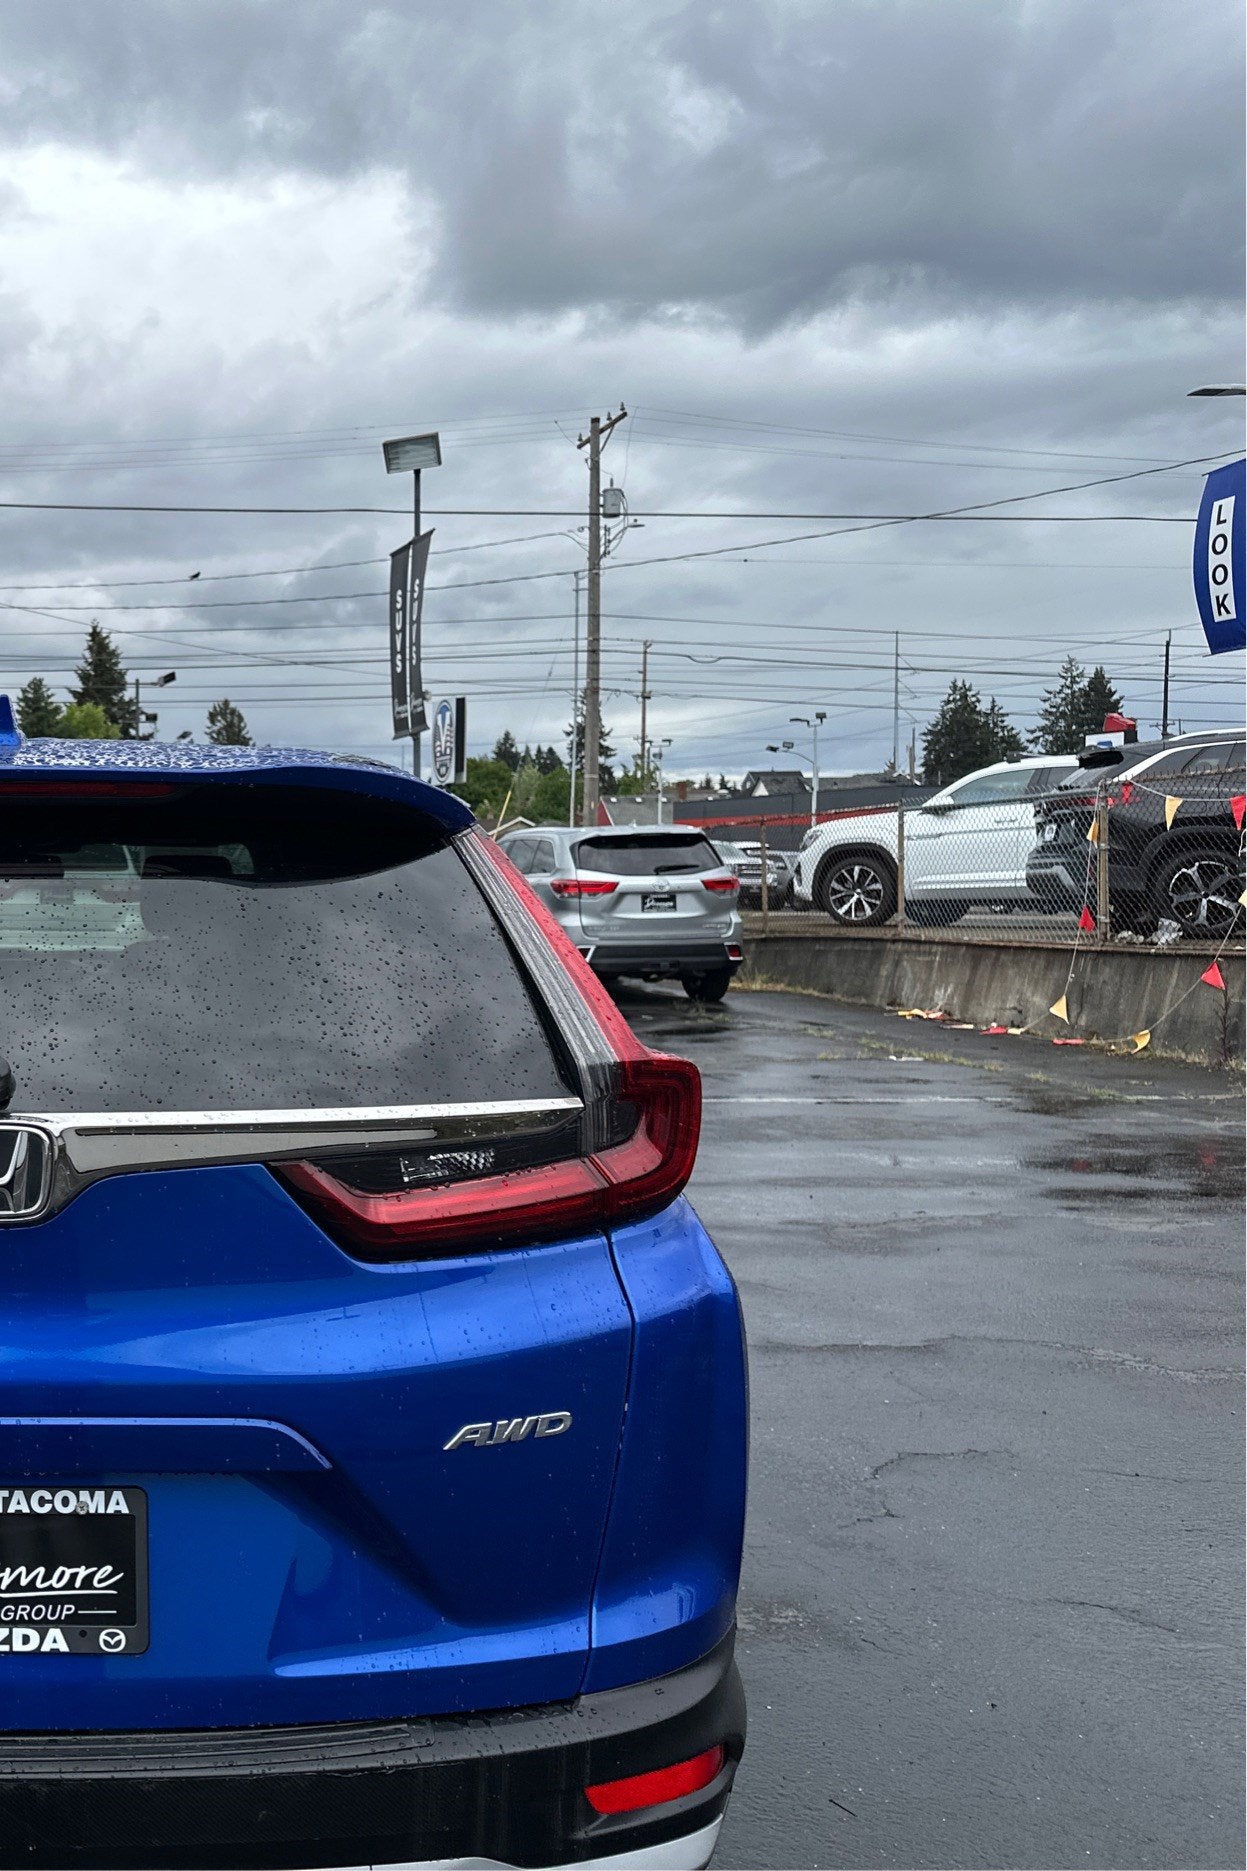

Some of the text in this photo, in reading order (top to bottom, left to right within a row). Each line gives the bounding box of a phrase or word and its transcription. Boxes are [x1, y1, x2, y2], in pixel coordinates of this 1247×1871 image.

[1211, 504, 1231, 617] LOOK
[395, 589, 403, 674] SUVS
[443, 1411, 573, 1450] AWD
[0, 1604, 76, 1621] GROUP
